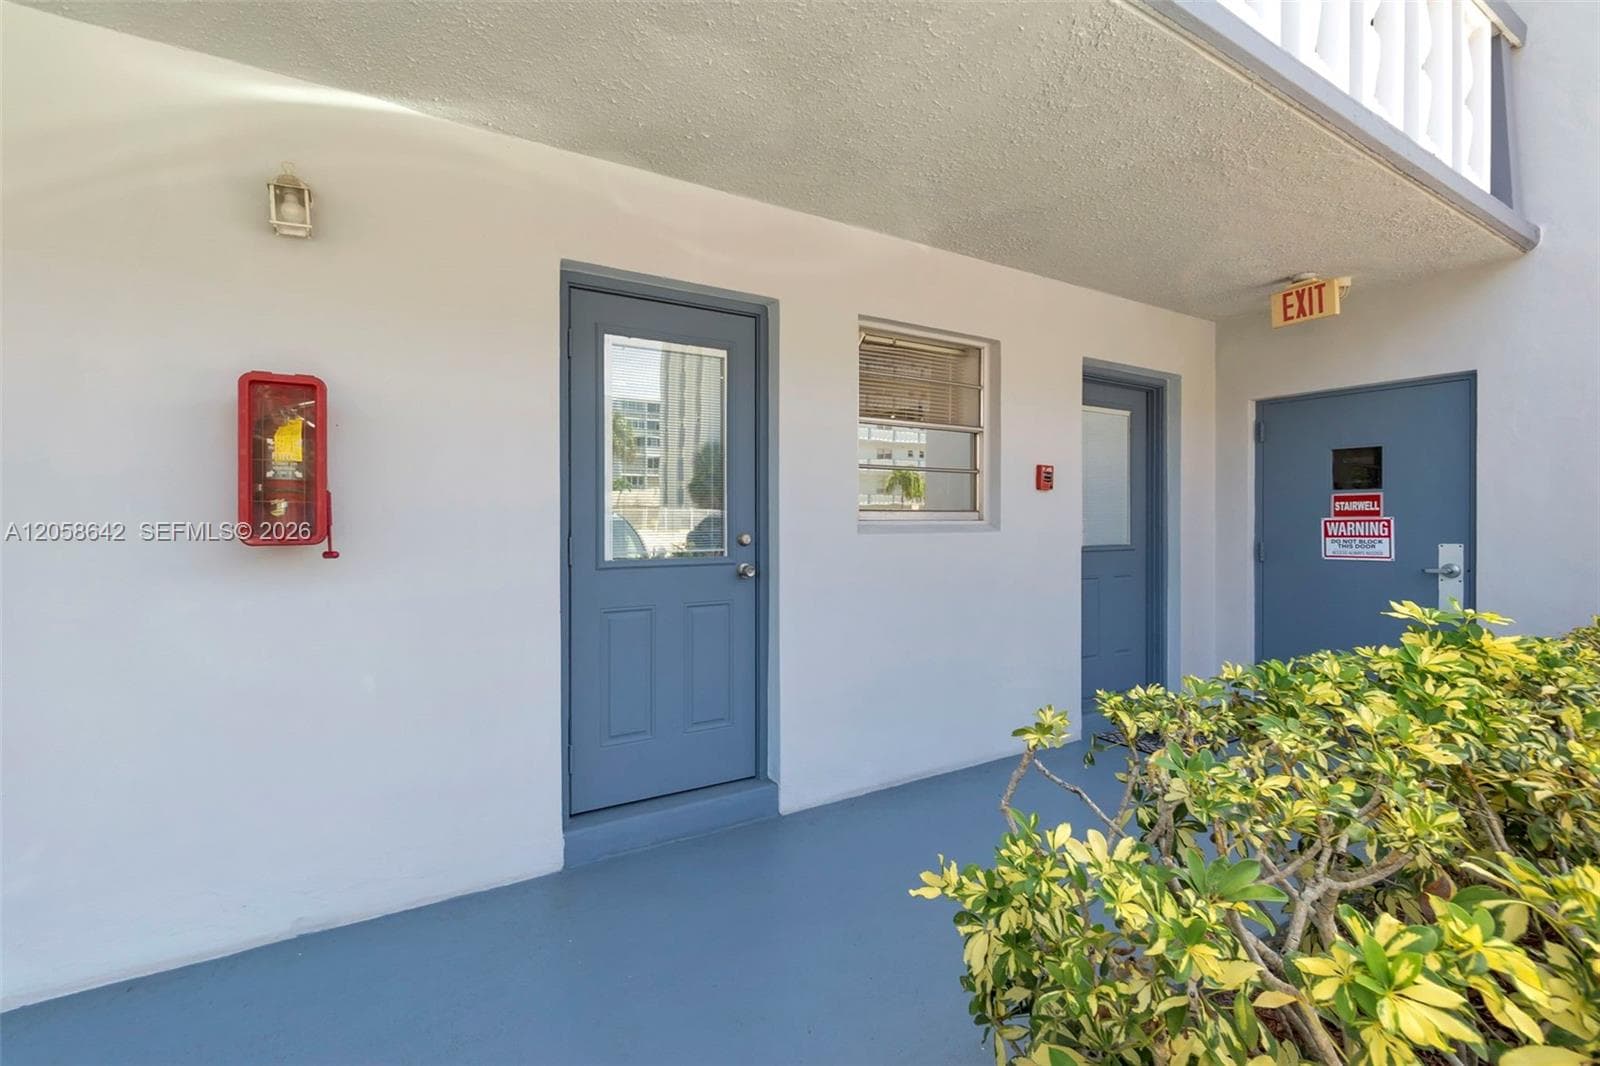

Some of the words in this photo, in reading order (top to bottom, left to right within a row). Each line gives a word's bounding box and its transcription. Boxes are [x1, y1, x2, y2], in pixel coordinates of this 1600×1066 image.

[1282, 283, 1326, 322] EXIT
[1334, 501, 1380, 511] STAIRWELL
[1326, 521, 1389, 536] WARNING
